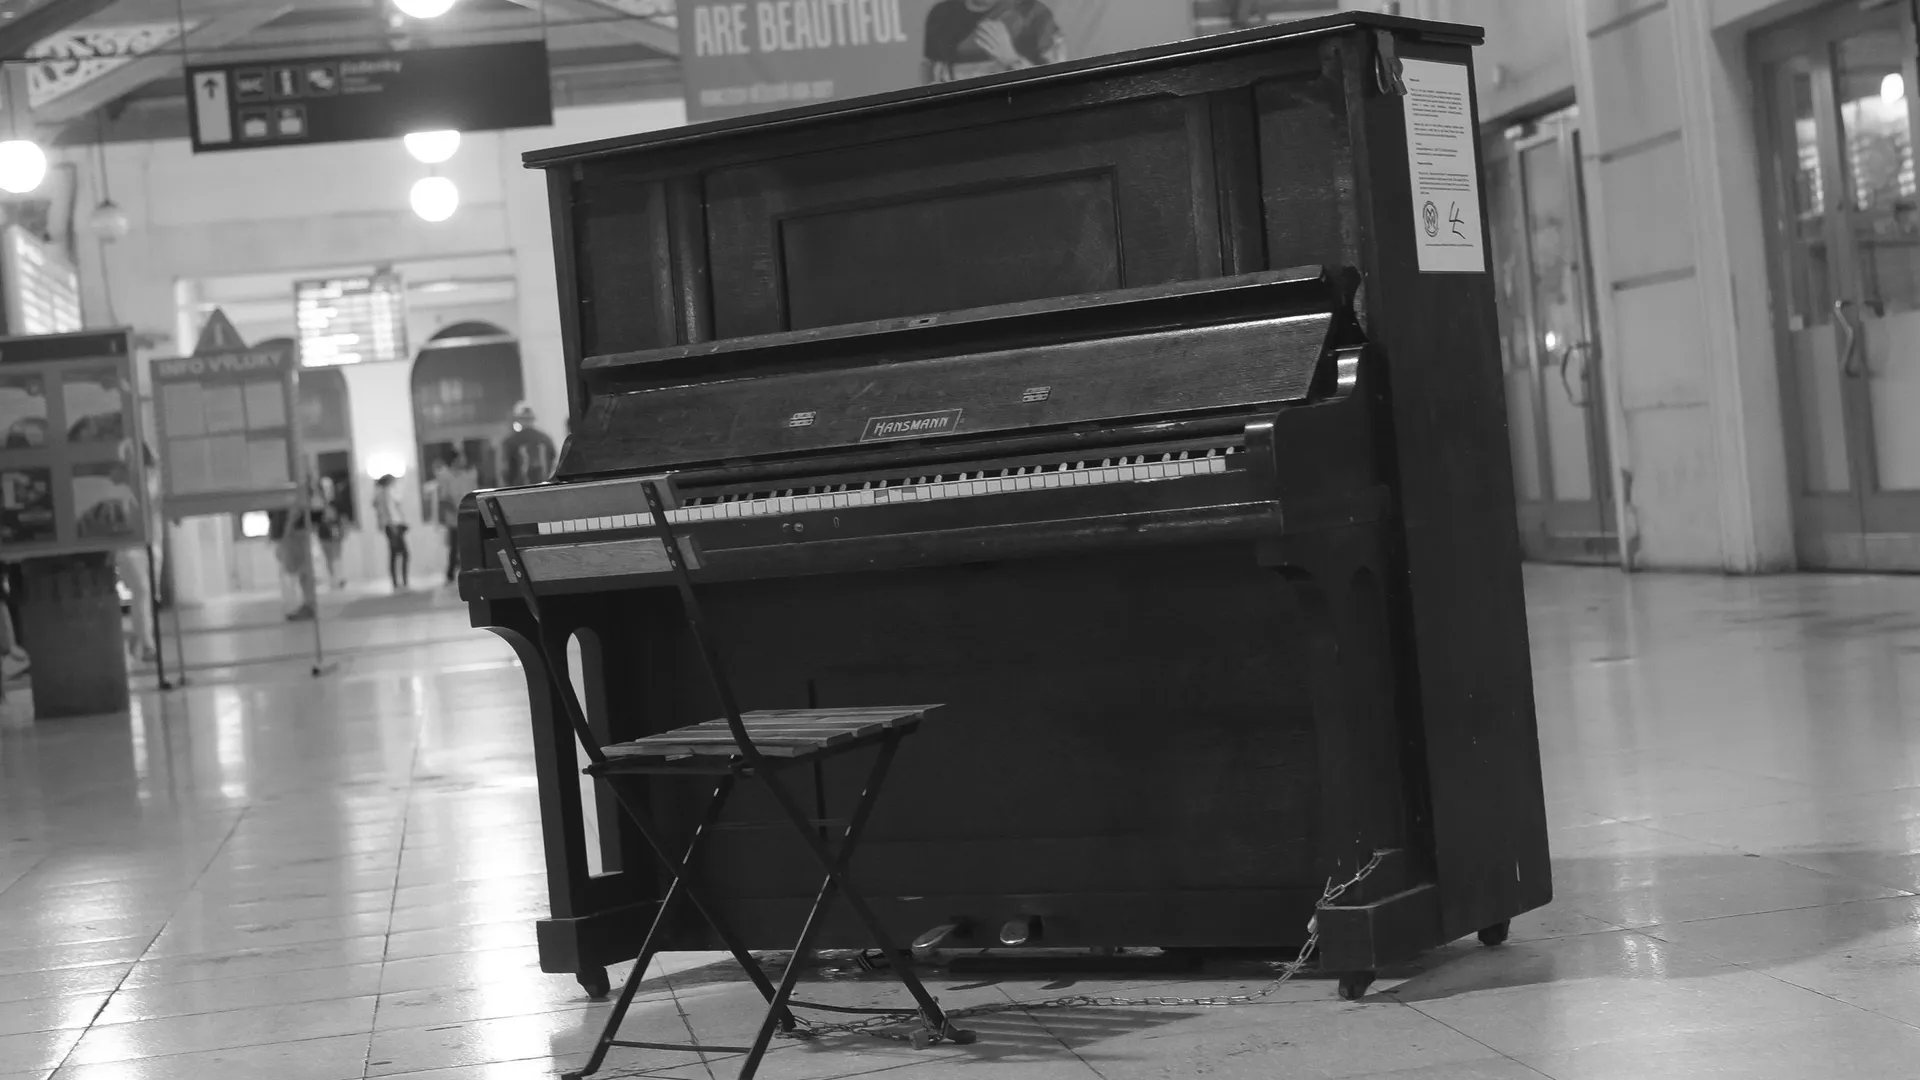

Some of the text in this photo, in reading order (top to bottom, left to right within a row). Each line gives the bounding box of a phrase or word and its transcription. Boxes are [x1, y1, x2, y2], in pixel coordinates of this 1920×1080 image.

[694, 0, 908, 57] ARE BEAUTIFUL
[873, 416, 949, 437] HANSMANN
